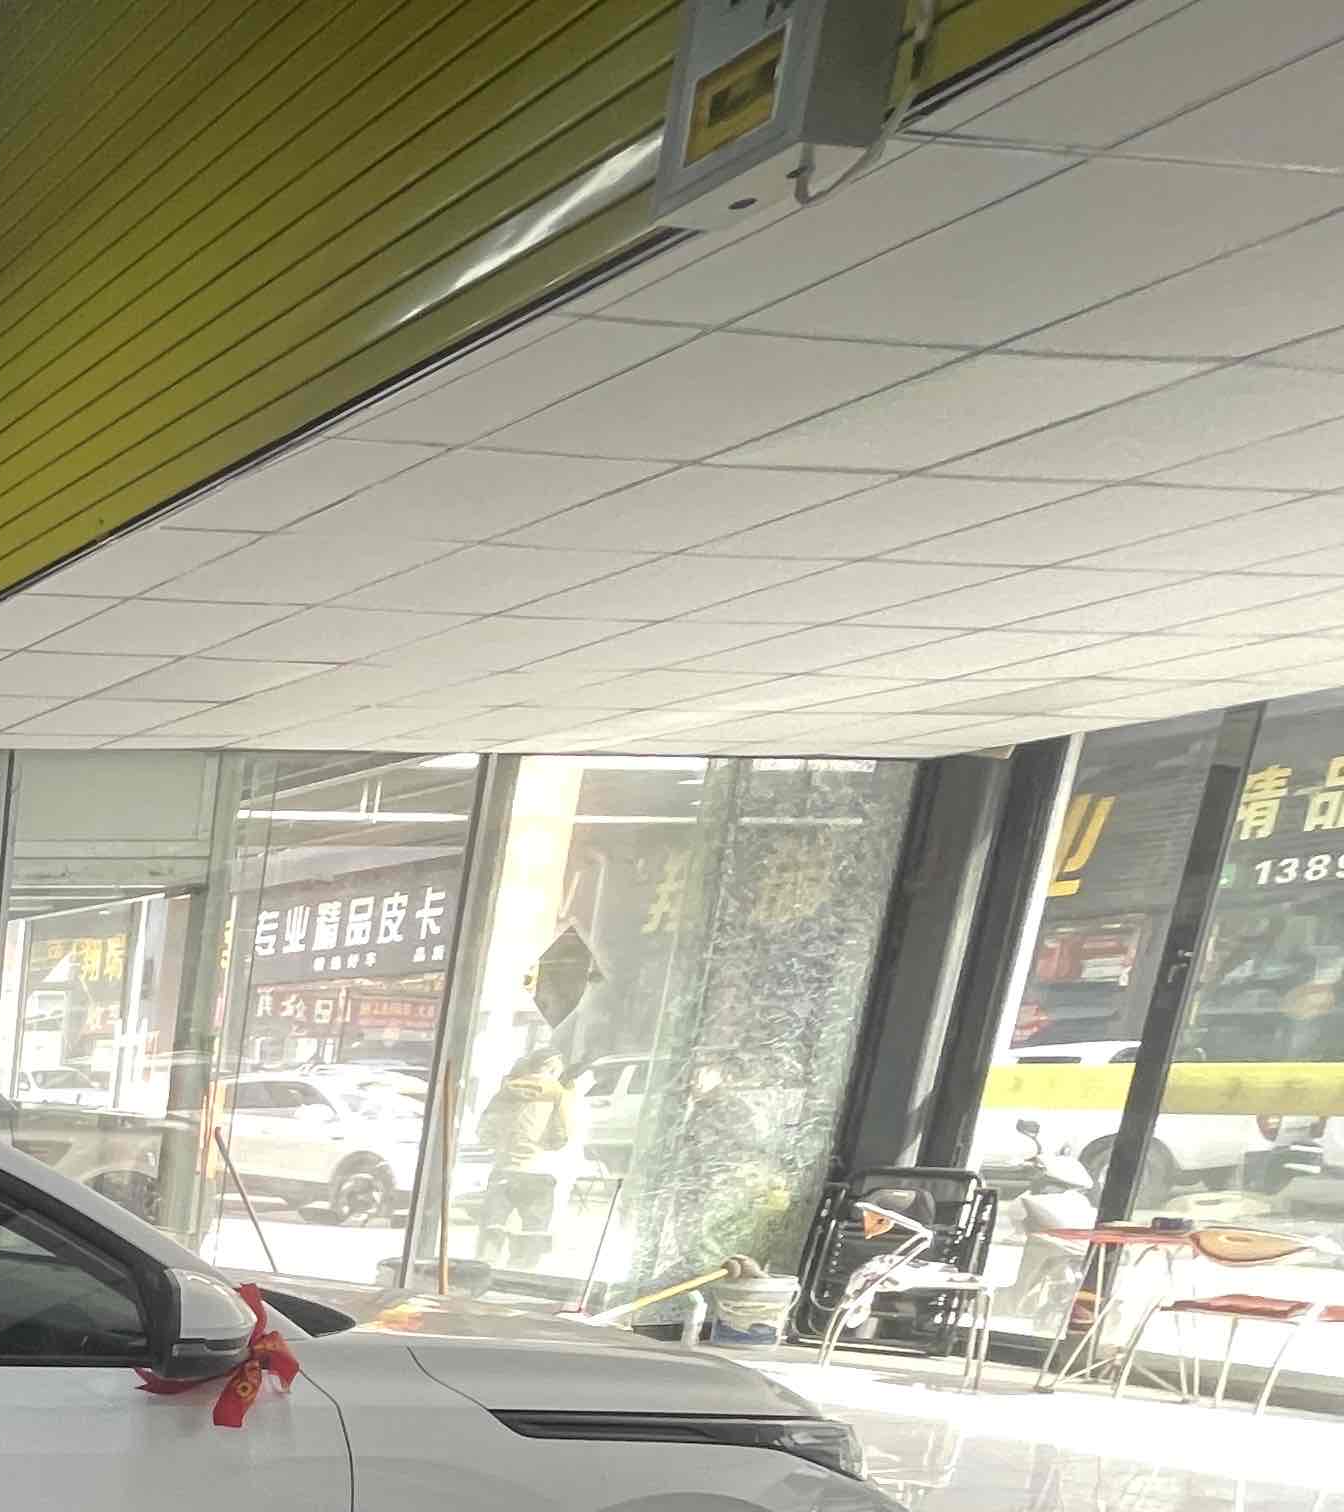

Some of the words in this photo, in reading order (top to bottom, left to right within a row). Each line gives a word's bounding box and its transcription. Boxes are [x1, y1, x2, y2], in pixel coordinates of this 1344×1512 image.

[254, 886, 447, 956] 专业精品皮卡
